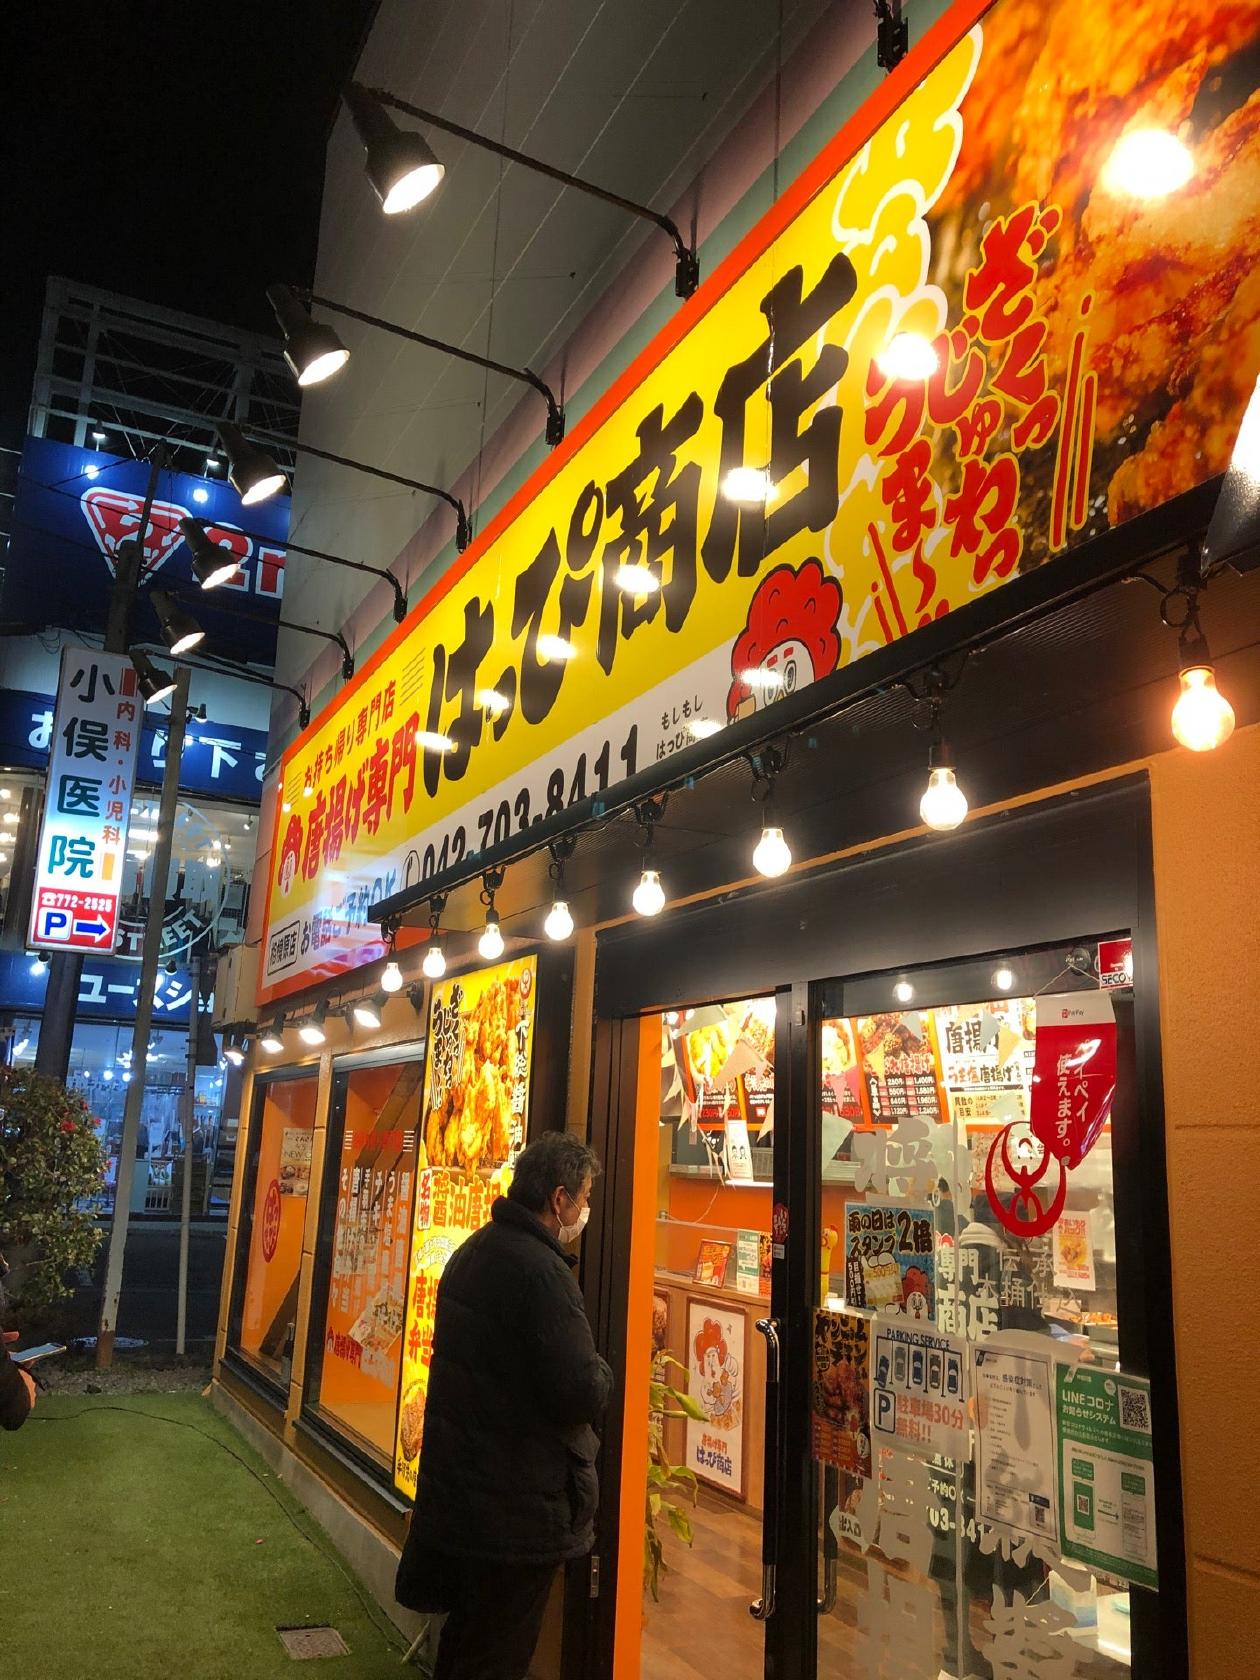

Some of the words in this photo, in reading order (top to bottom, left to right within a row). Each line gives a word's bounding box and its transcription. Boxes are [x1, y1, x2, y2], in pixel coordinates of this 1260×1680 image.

[422, 251, 858, 798] はっぴ商店
[661, 694, 704, 731] もしもし
[303, 680, 397, 788] お持ち帰り専門店
[47, 663, 115, 879] 小俣医院
[301, 711, 420, 883] 唐揚げ専門
[44, 912, 68, 936] P
[117, 909, 204, 951] STEET
[1056, 1053, 1072, 1148] 使えます。
[848, 1208, 896, 1234] 雨の日は
[897, 1210, 933, 1254] 2倍
[850, 1232, 897, 1257] スタンプ
[886, 1328, 920, 1345] PARKING
[920, 1333, 951, 1350] SERVICE
[878, 1394, 891, 1425] P
[1062, 1389, 1114, 1412] LINEコロナ
[1062, 1404, 1117, 1425] お知らせシステム
